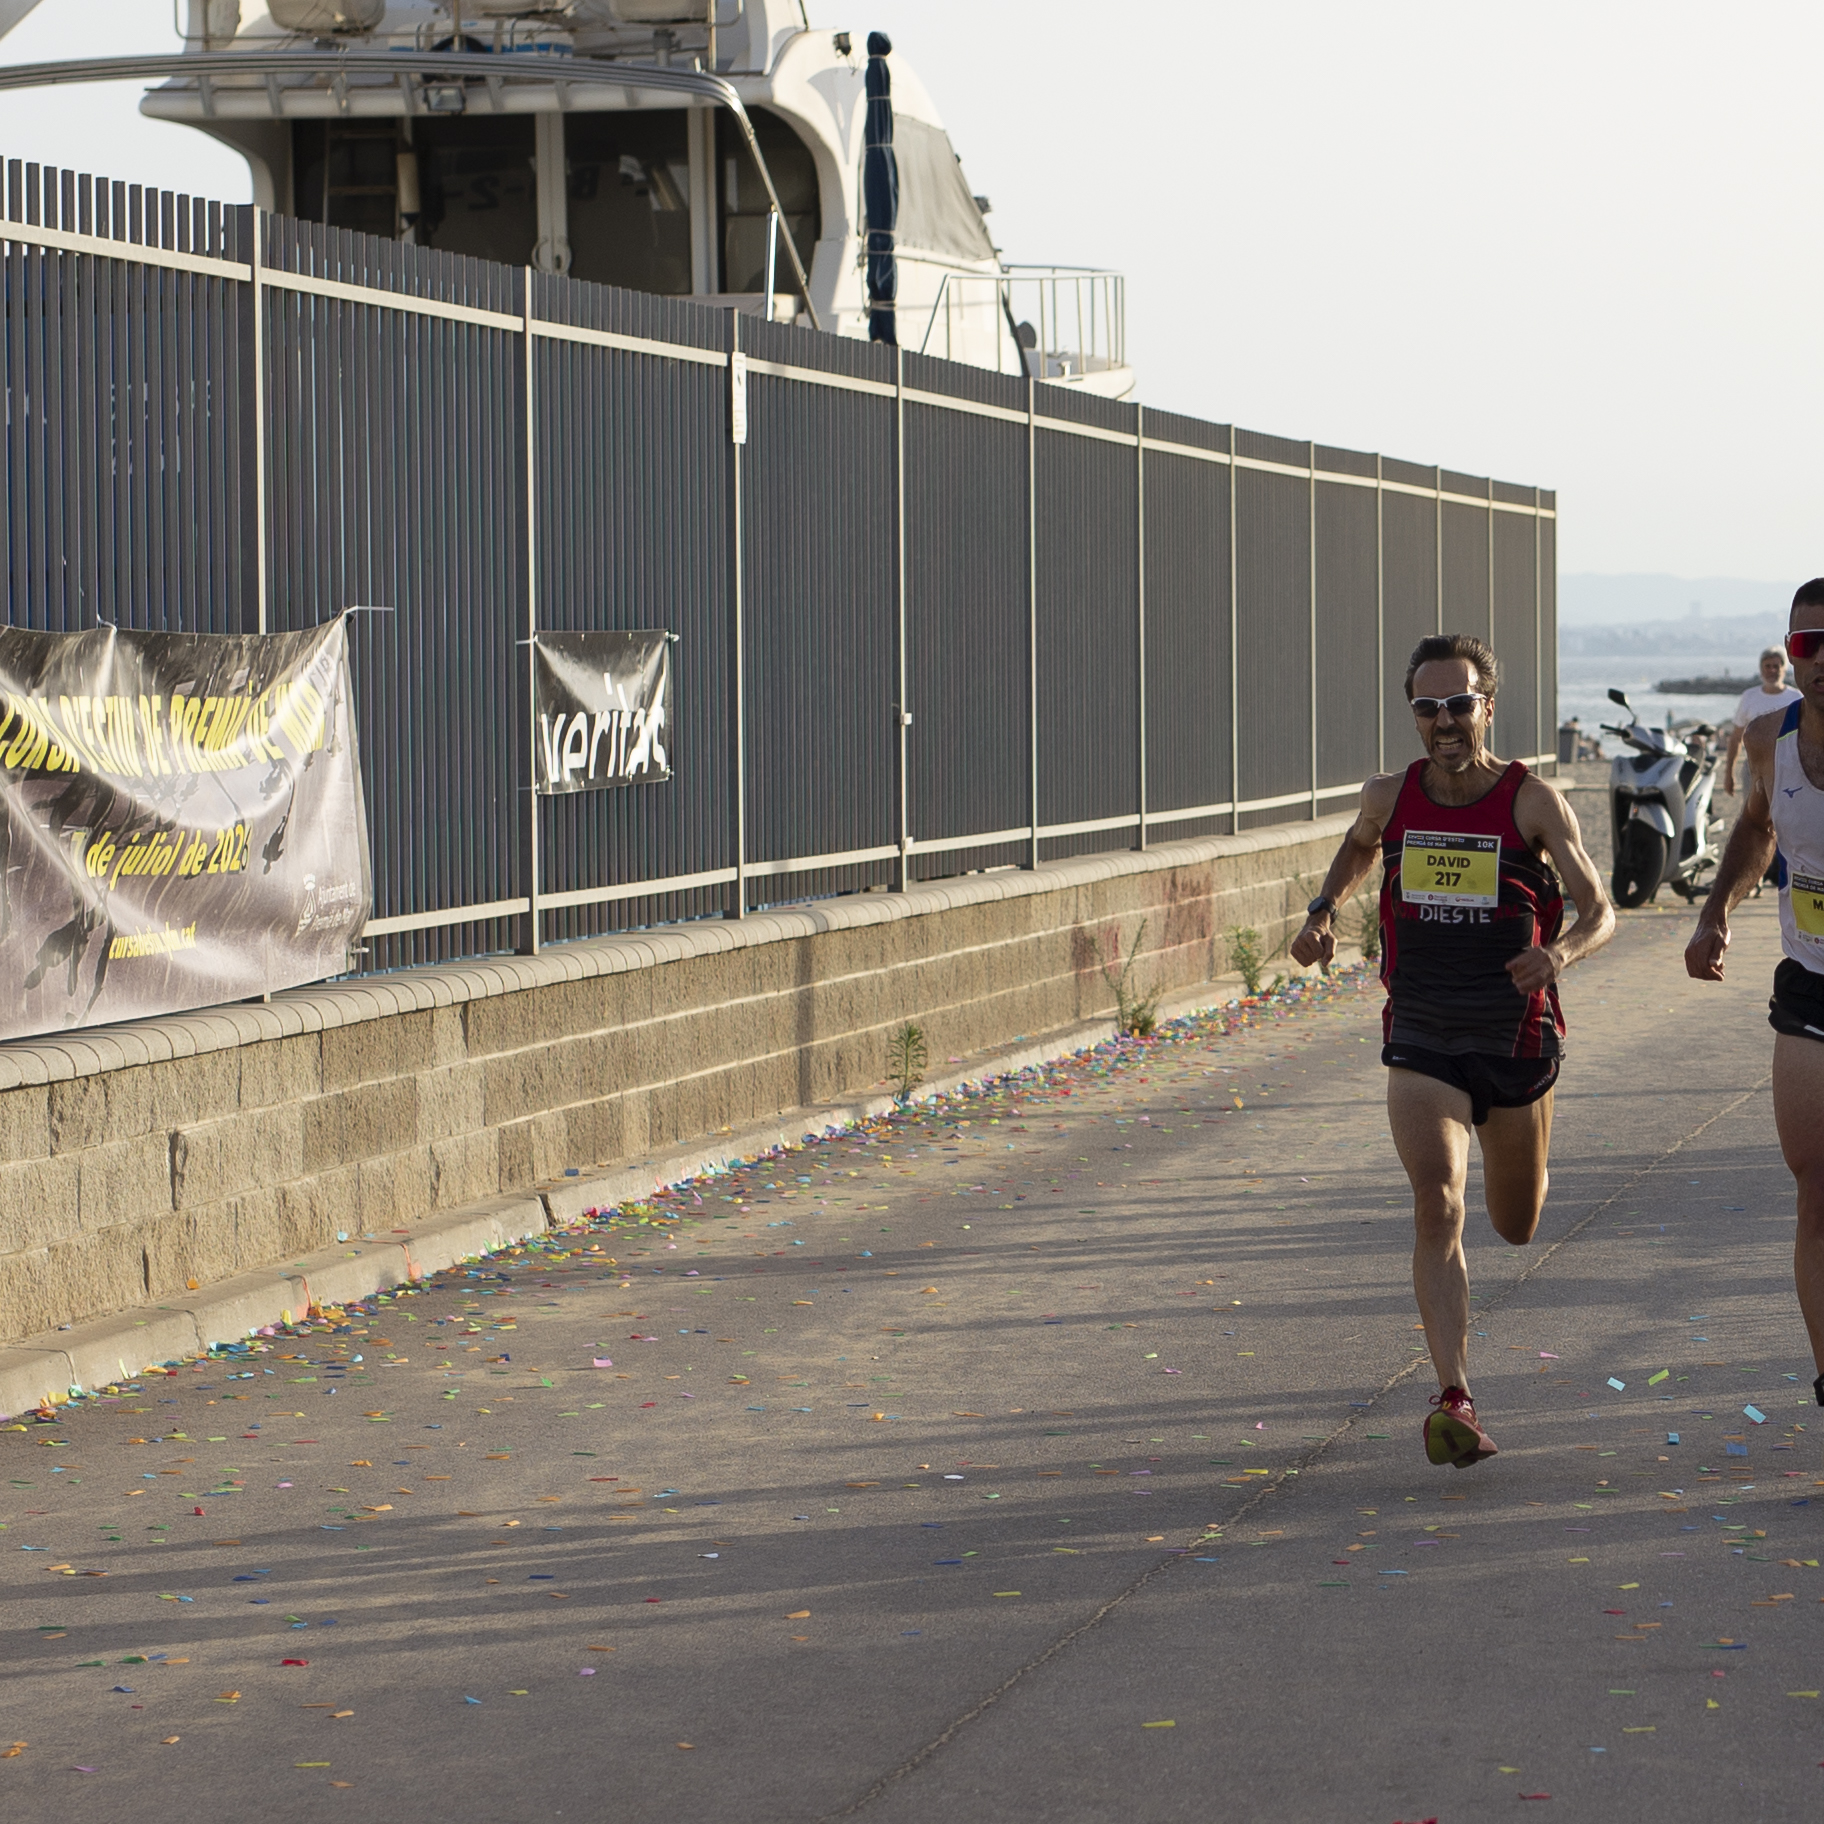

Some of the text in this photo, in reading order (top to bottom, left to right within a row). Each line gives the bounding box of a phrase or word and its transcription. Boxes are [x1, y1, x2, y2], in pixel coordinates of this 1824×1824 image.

[60, 695, 143, 777] D'ESTIU
[139, 694, 172, 775] DE
[541, 672, 667, 783] veritas
[86, 831, 115, 877] de
[109, 830, 185, 891] juliol
[178, 829, 208, 875] de
[1427, 855, 1471, 868] DAVID
[1477, 840, 1495, 848] 10K
[1435, 871, 1461, 886] 217
